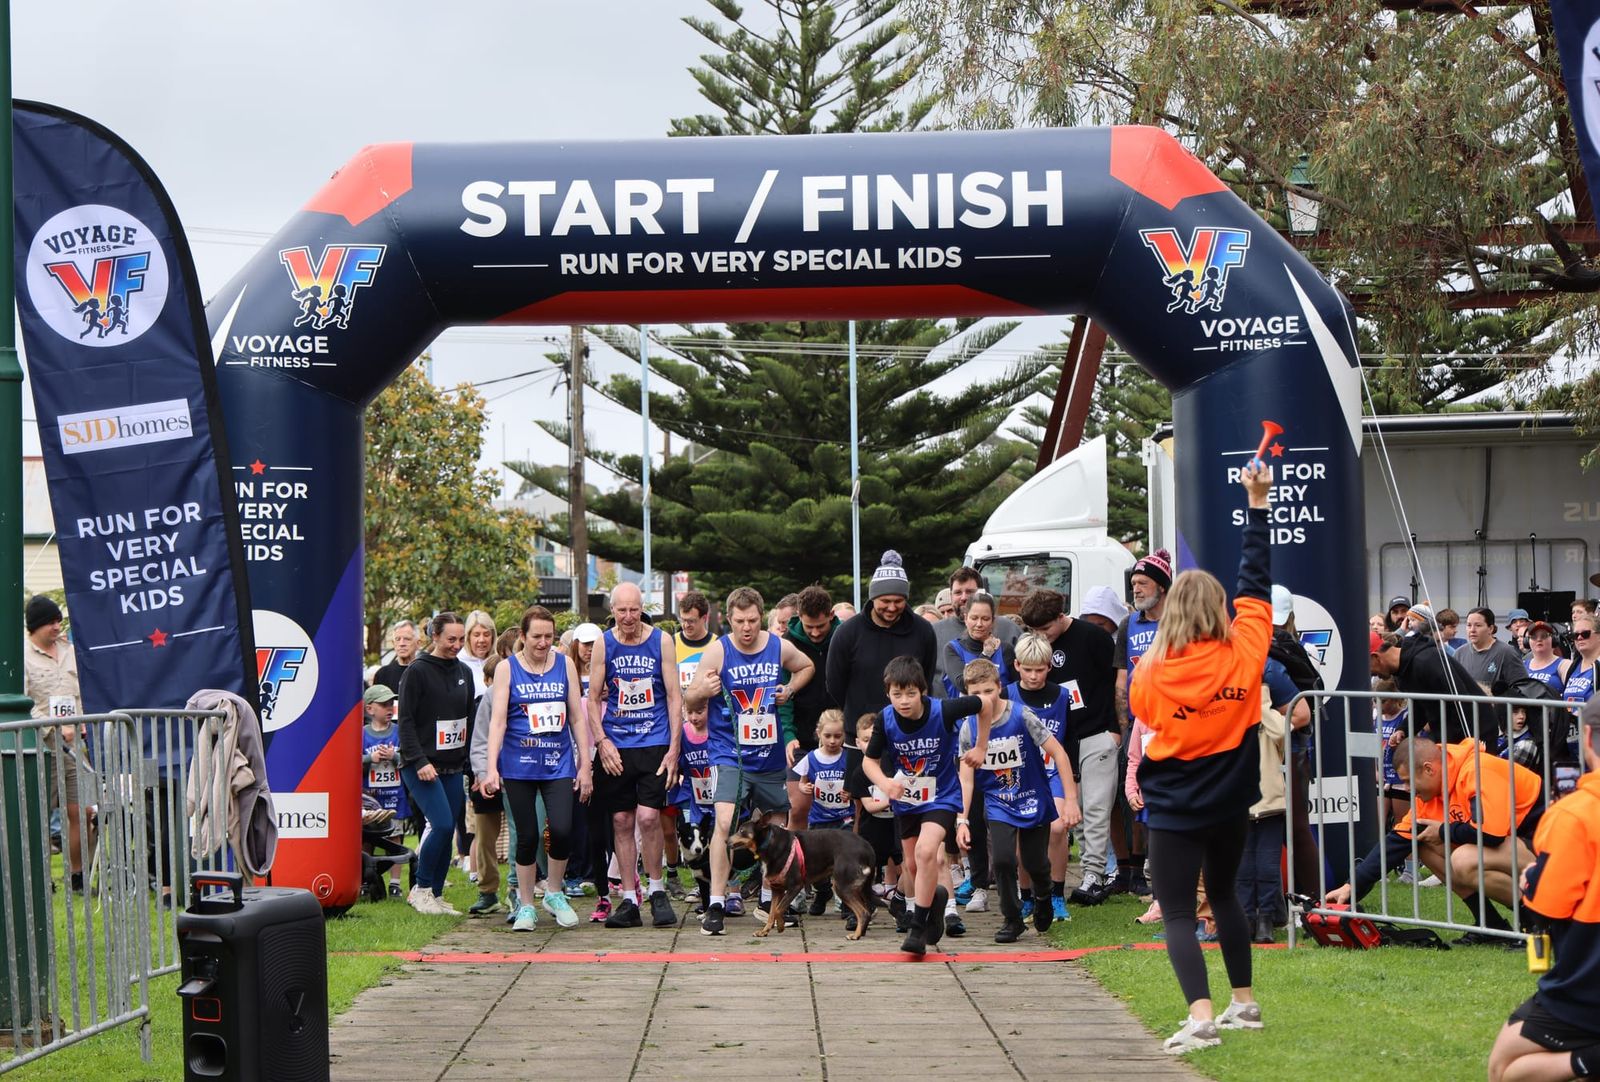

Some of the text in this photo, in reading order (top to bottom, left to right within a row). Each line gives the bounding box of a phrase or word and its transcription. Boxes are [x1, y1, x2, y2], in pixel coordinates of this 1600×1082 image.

[461, 170, 1063, 243] START / FINISH
[43, 225, 137, 254] VOYAGE
[78, 245, 112, 255] FITNESS
[561, 246, 962, 275] RUN FOR VERY SPECIAL KIDS
[1201, 315, 1299, 337] VOYAGE
[232, 335, 329, 354] VOYAGE
[1220, 338, 1281, 351] FITNESS
[250, 356, 310, 368] FITNESS
[63, 415, 190, 446] SJDhomes
[1281, 463, 1326, 480] FOR
[262, 482, 308, 499] FOR
[1266, 485, 1308, 502] ERY
[77, 502, 202, 538] RUN FOR
[1232, 506, 1325, 525] SECIAL
[241, 523, 304, 540] ECIAL
[1269, 527, 1306, 544] IDS
[106, 532, 179, 562] VERY
[243, 544, 284, 561] IDS
[89, 555, 207, 592] SPECIAL
[120, 584, 185, 614] KIDS
[612, 655, 656, 669] VOYAGE
[728, 662, 780, 679] VOYAGE
[743, 675, 769, 685] FITNESS
[1528, 672, 1551, 681] AGE
[516, 682, 565, 695] VOYAGE
[624, 693, 646, 705] 268
[538, 714, 561, 727] 117
[1040, 718, 1061, 732] AGE
[445, 732, 463, 744] 374
[751, 728, 768, 740] 30
[893, 738, 941, 751] VOYAGE
[685, 750, 709, 762] VOYA
[376, 771, 396, 782] 258
[820, 791, 842, 804] 308
[903, 787, 921, 801] 34
[1307, 793, 1359, 815] omes
